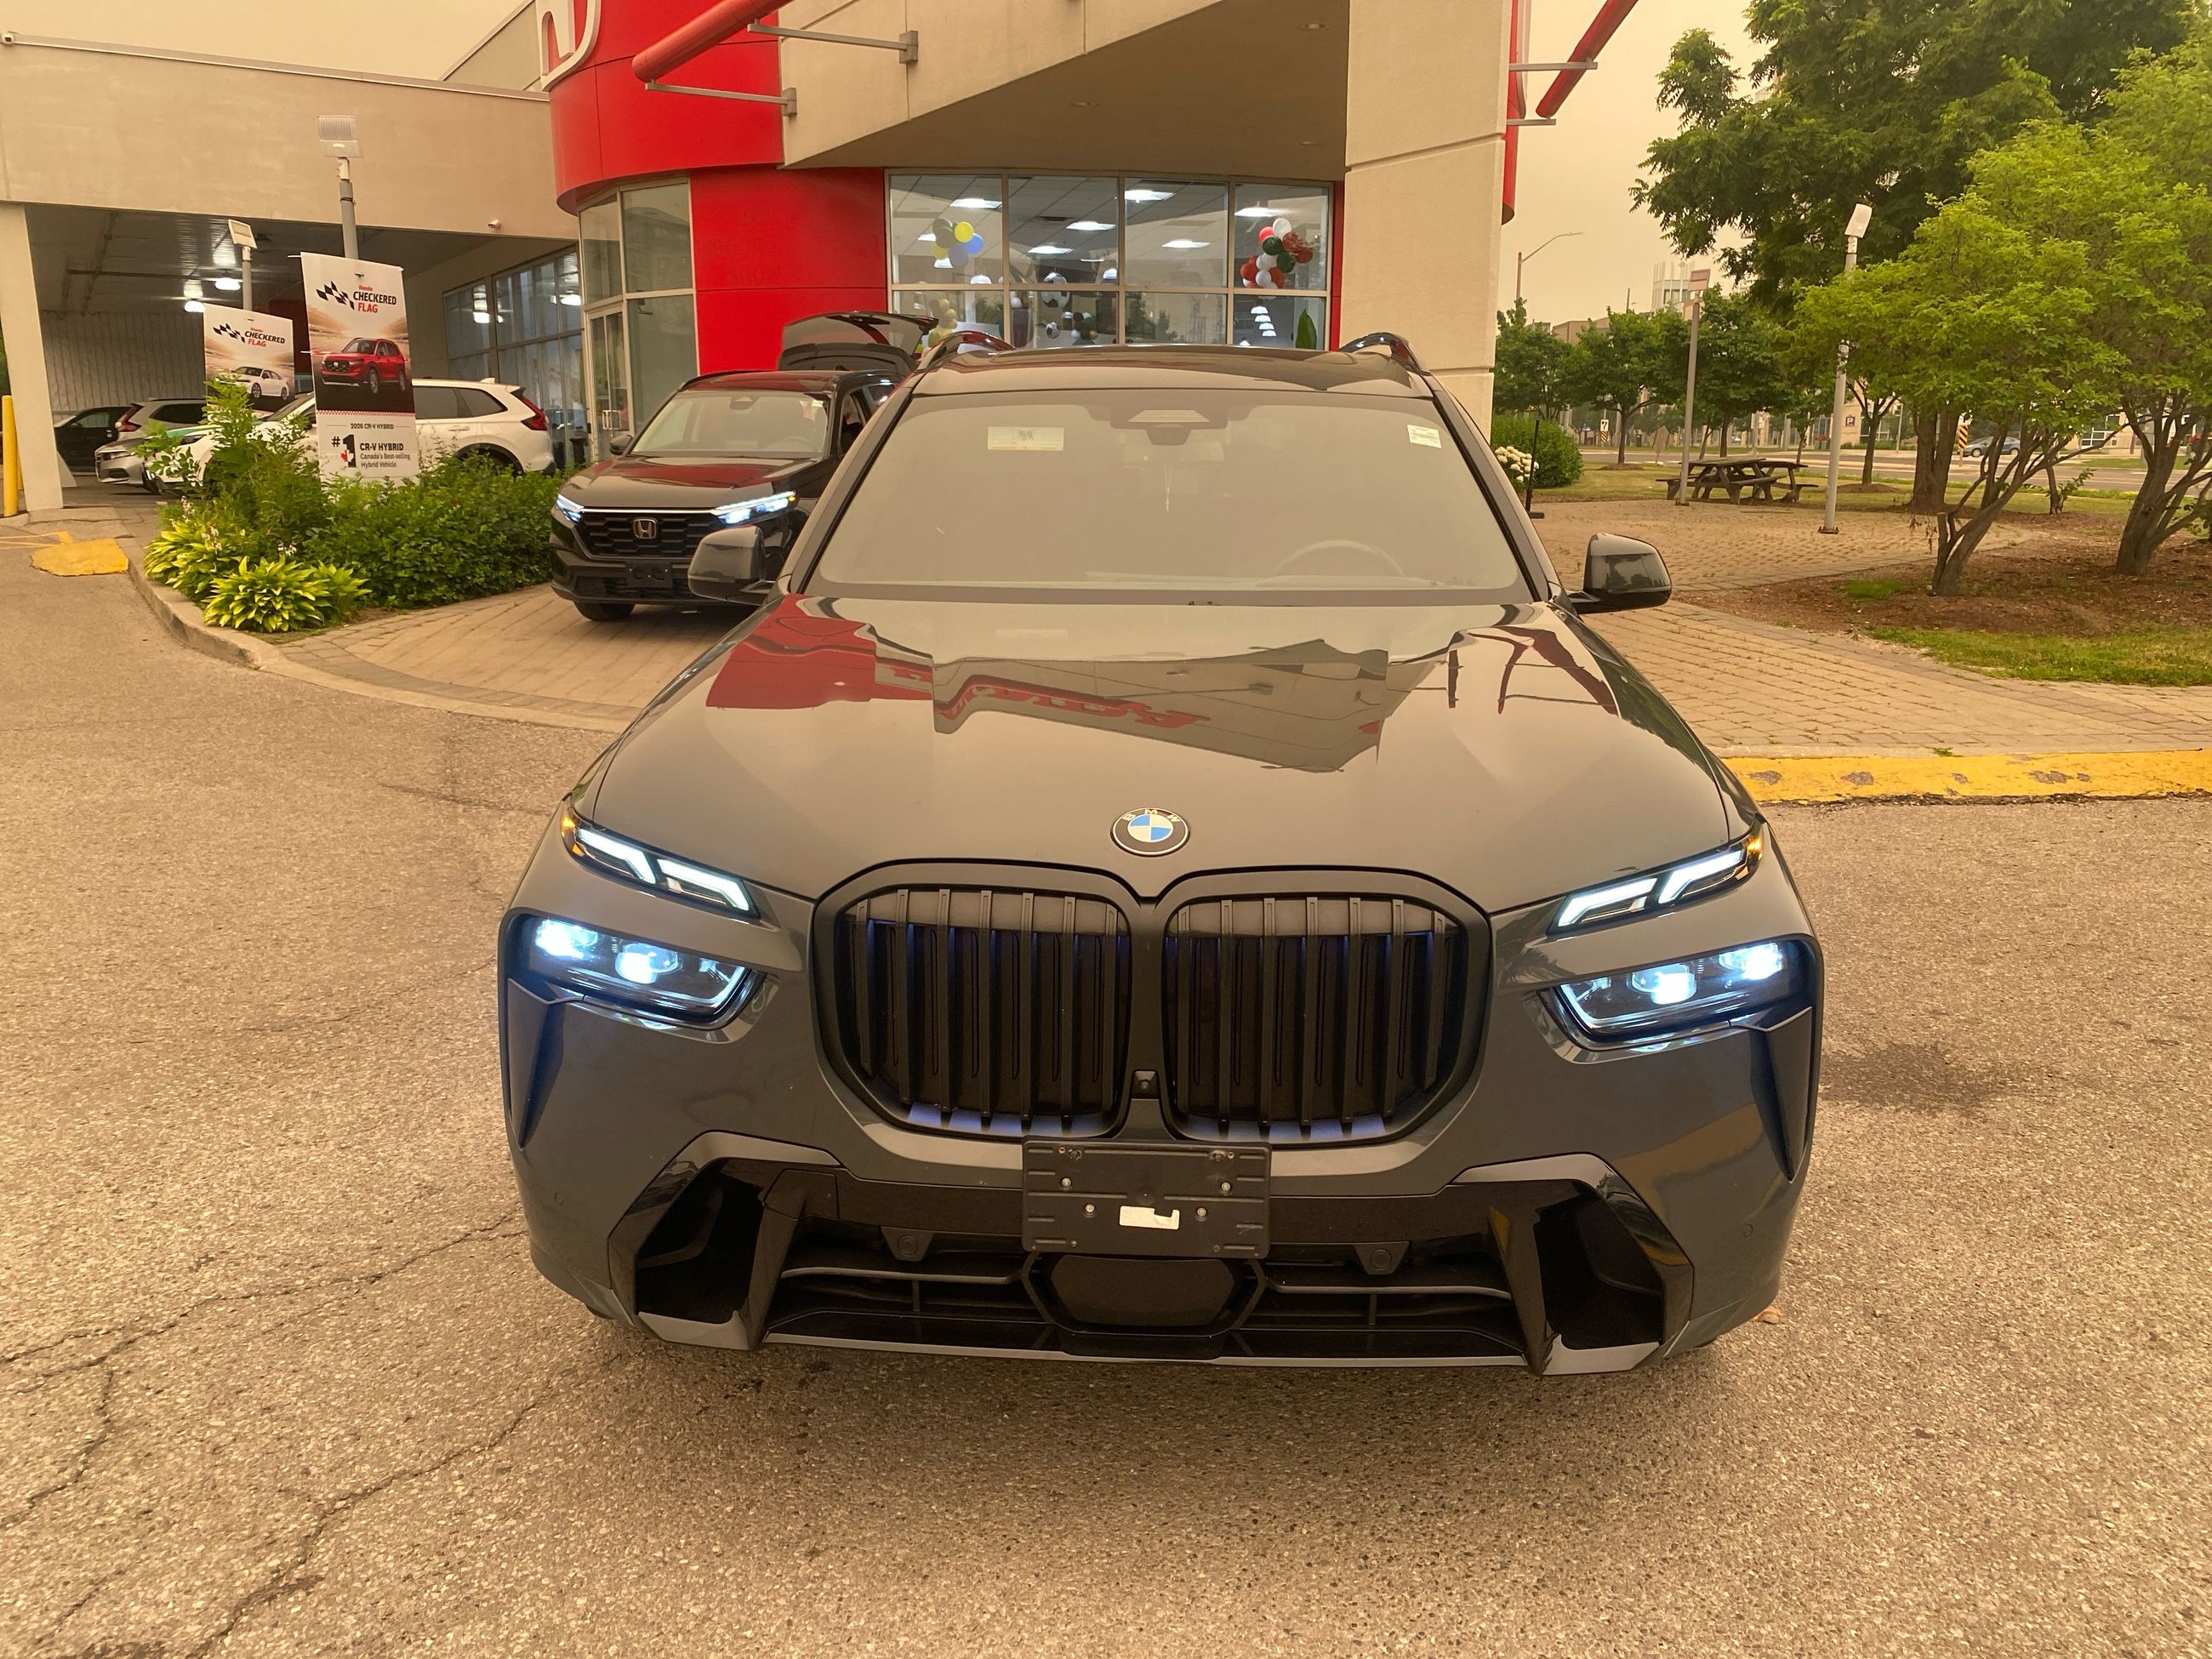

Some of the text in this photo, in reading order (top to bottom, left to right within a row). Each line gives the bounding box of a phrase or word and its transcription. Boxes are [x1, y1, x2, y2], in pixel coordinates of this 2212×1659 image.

[353, 291, 396, 305] CHECKERED
[357, 303, 378, 313] FLAG
[244, 330, 286, 344] CHECKERED
[248, 338, 266, 347] FLAG
[360, 442, 377, 451] CR-V
[361, 461, 379, 470] Hybrid
[1121, 808, 1182, 823] BMW
